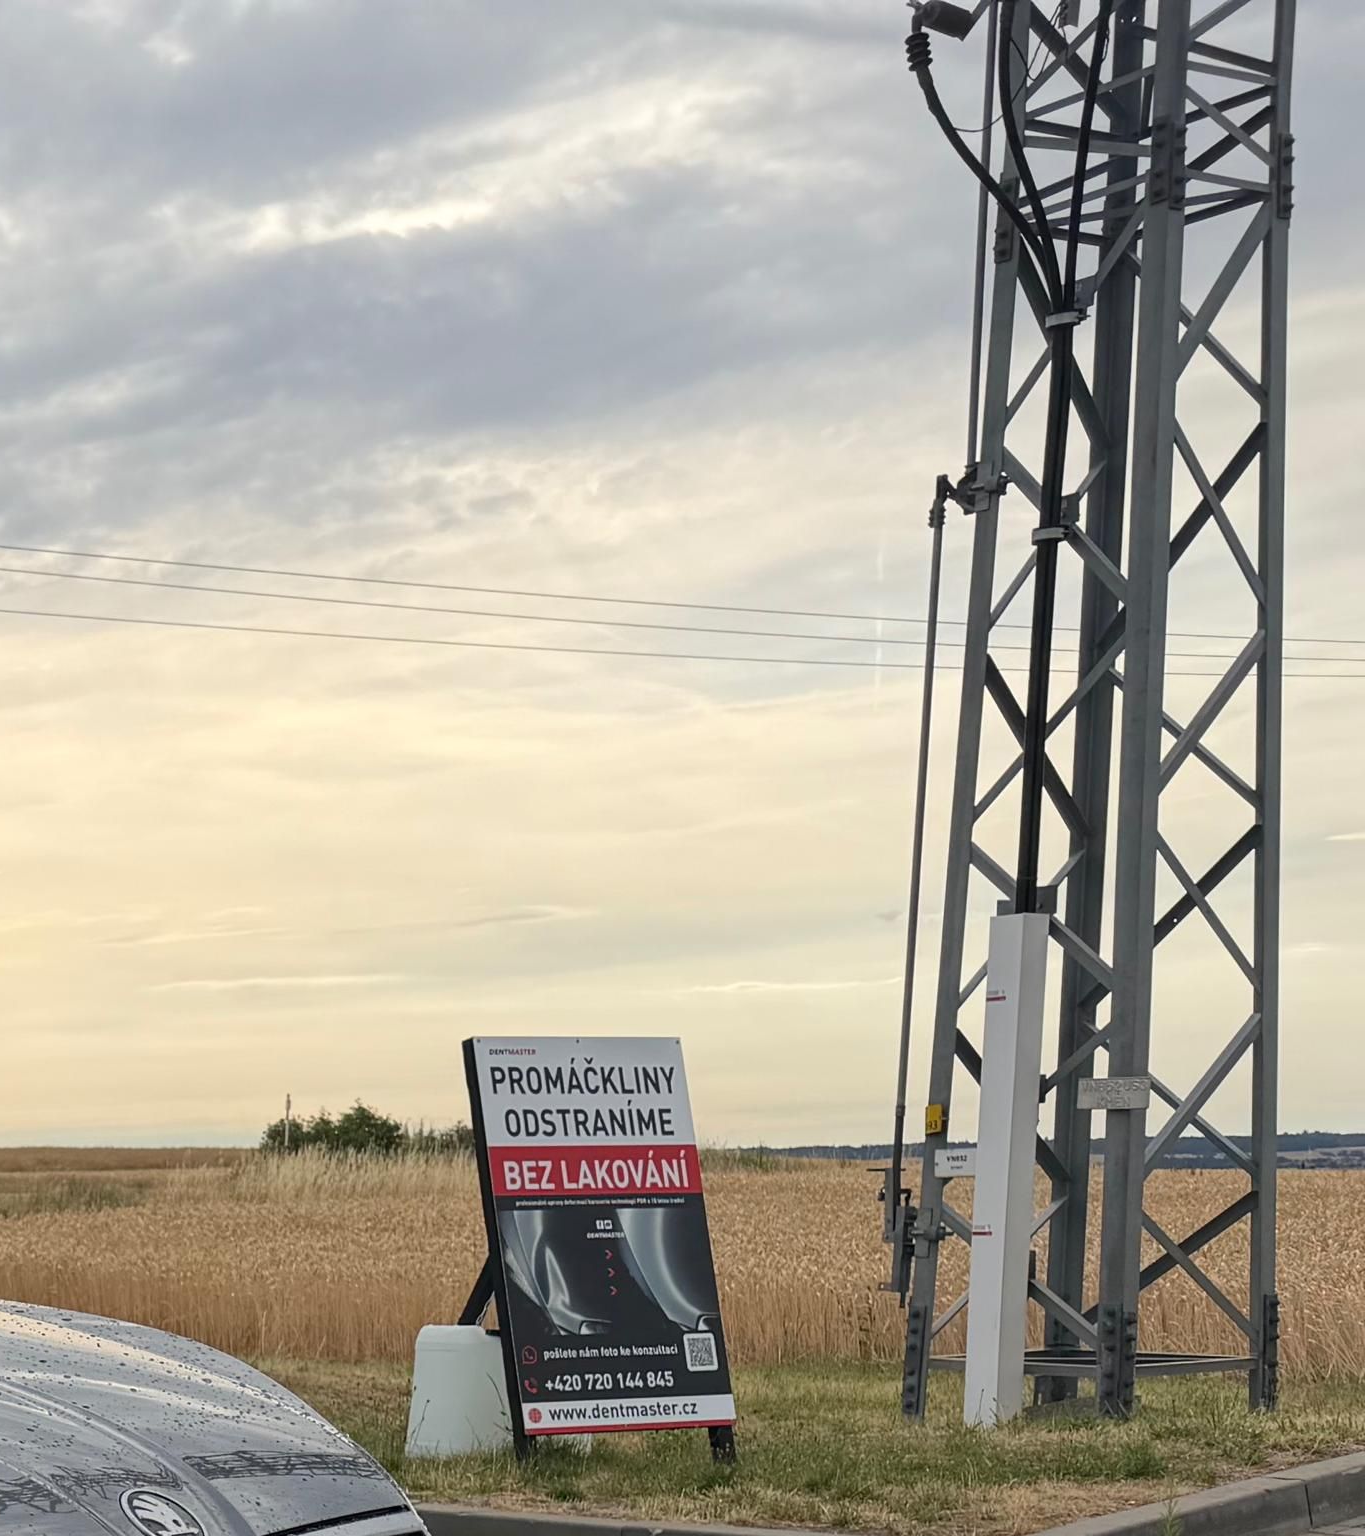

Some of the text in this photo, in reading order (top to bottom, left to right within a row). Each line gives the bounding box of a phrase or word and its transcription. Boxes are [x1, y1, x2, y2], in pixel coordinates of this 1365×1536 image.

[488, 1048, 537, 1056] DENTMASTER
[489, 1057, 675, 1095] PROMÁČKLINY
[504, 1099, 675, 1138] ODSTRANÍME
[503, 1149, 690, 1191] BEZ LAKOVÁNÍ
[543, 1343, 679, 1361] pošlete nám foto ke konzultaci
[545, 1370, 675, 1392] +420 720 144 845
[548, 1401, 699, 1422] www.dentmaster.cz
